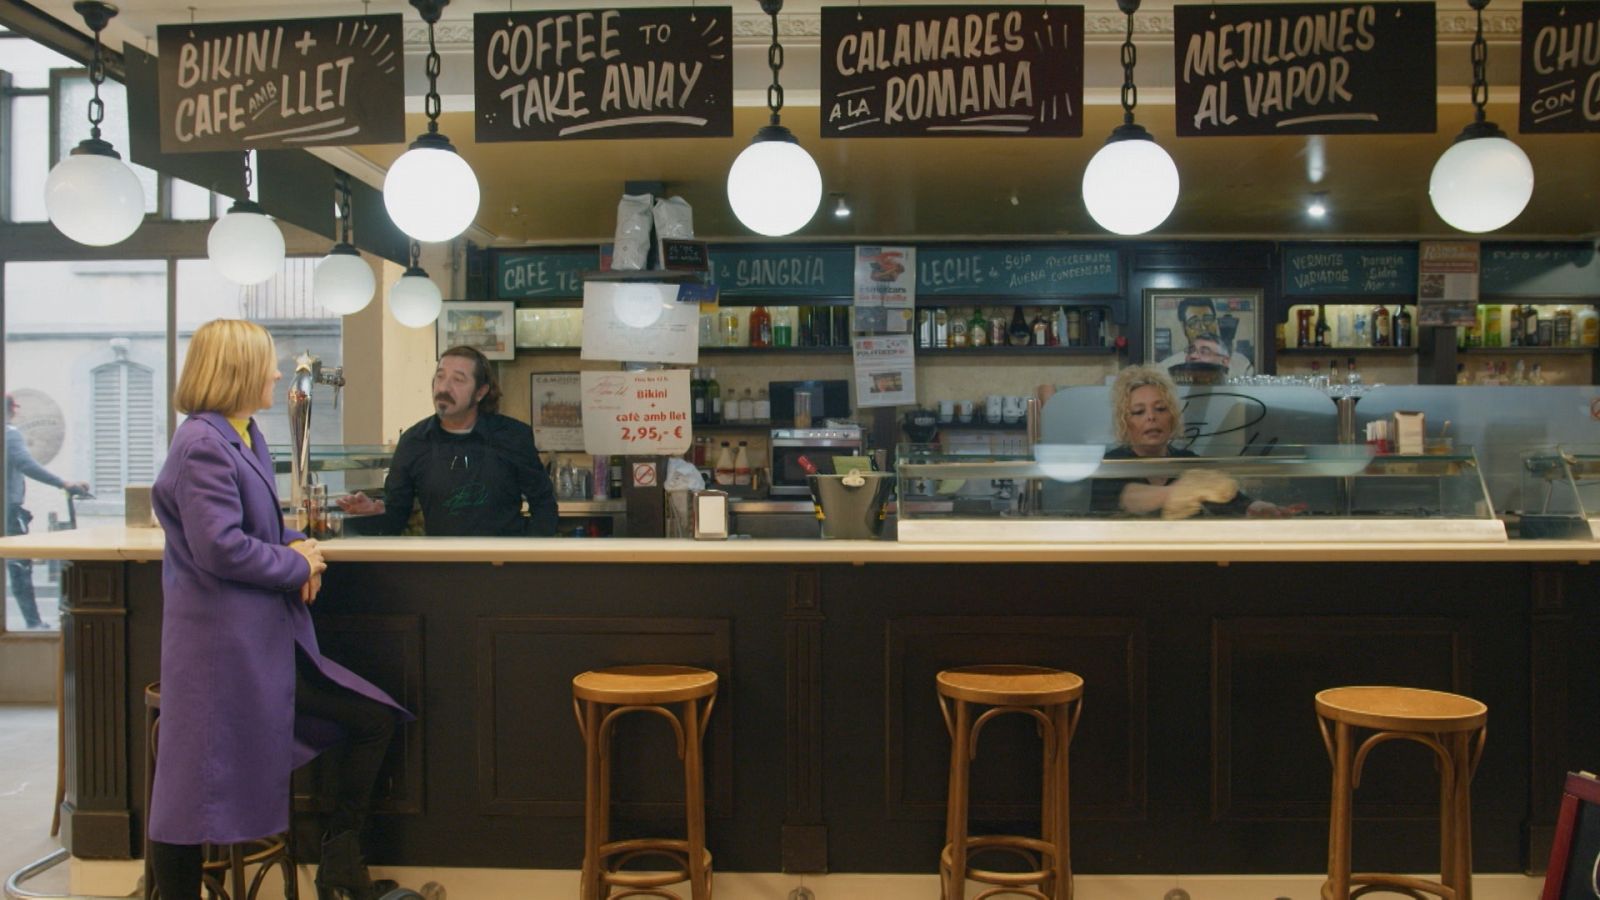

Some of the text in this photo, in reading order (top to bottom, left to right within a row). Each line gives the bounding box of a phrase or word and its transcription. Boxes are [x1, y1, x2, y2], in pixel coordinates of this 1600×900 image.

[178, 26, 317, 89] BIKINI +
[487, 10, 671, 80] COFFEE TO
[836, 10, 1025, 76] CALAMARES
[1184, 5, 1376, 83] MEJILLONES
[249, 81, 277, 113] AMB
[280, 56, 355, 118] LLET
[500, 61, 703, 129] TAKE AWAY
[829, 60, 1034, 125] A LA ROMANA
[1194, 56, 1353, 130] AL VAPOR
[1531, 88, 1576, 115] CON
[737, 255, 825, 287] SANGRÍA
[921, 256, 984, 288] LECHE
[636, 389, 668, 399] Bikini
[643, 411, 667, 421] amb
[669, 410, 687, 421] llet
[674, 425, 683, 439] €
